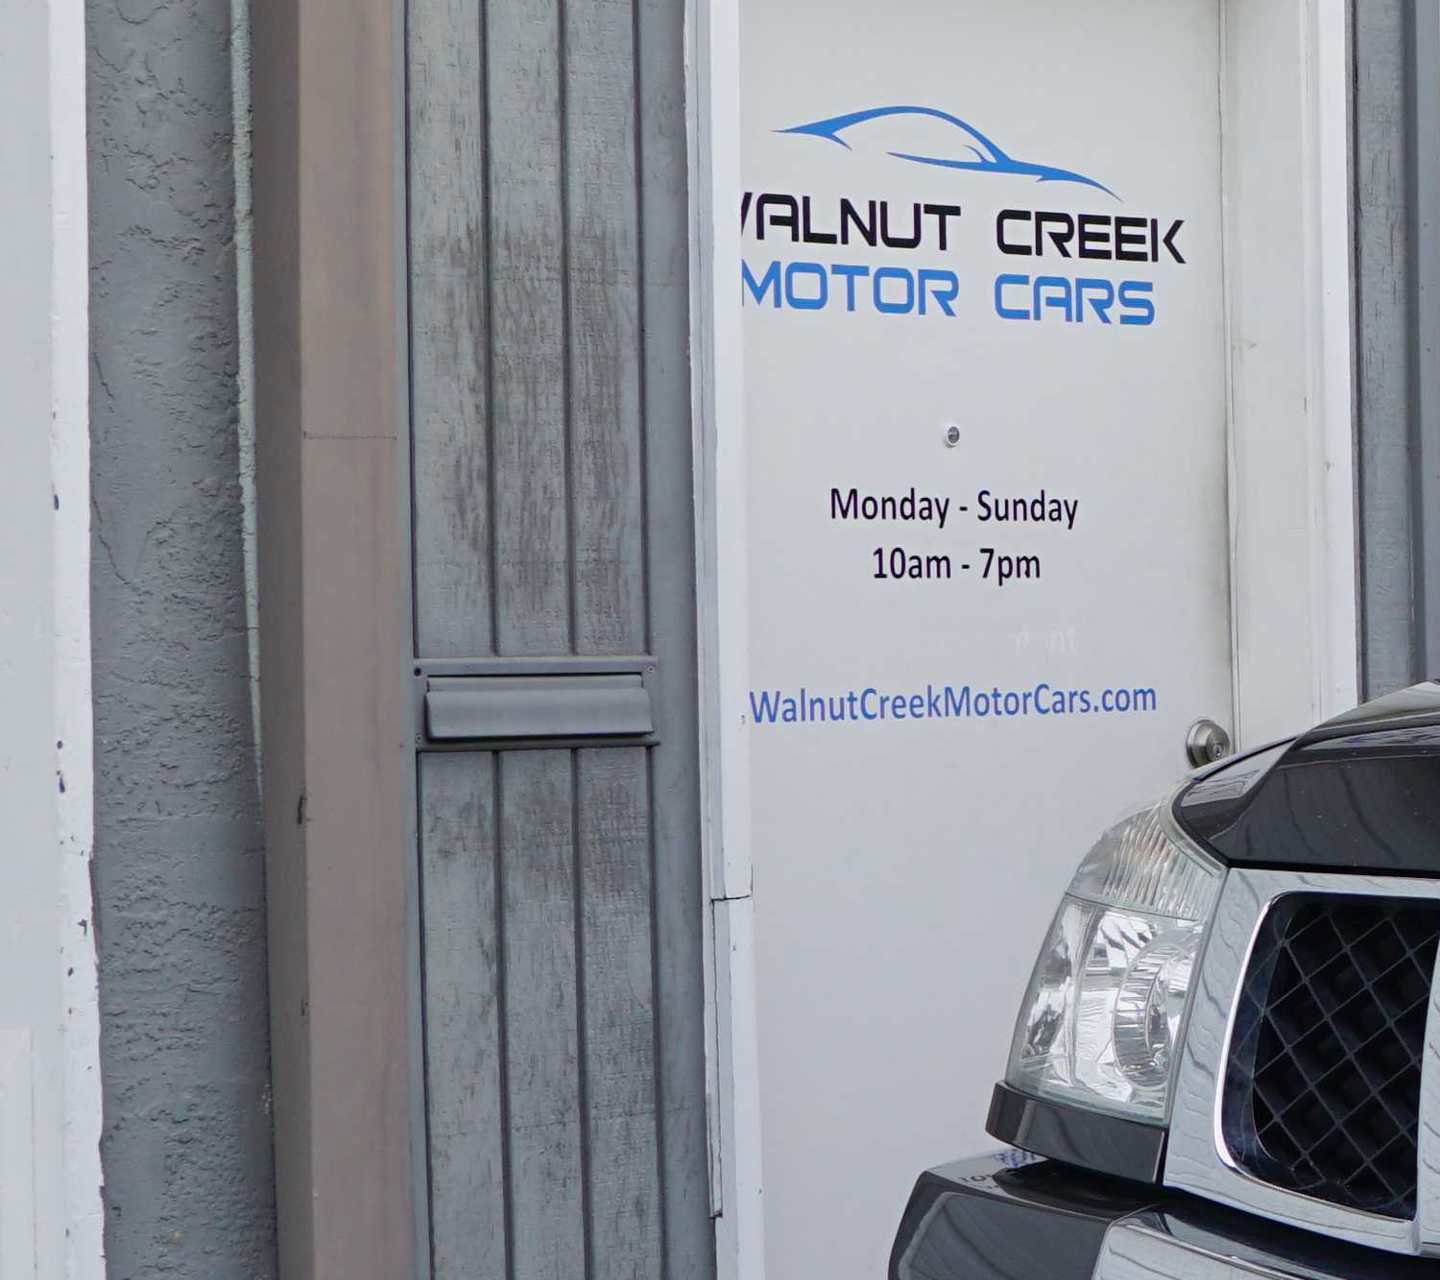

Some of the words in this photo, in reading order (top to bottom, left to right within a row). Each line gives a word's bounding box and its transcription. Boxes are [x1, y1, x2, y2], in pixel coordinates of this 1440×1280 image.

[740, 192, 961, 251] ALNUT
[996, 209, 1187, 264] CREEK
[741, 258, 960, 317] MOTOR
[994, 273, 1156, 326] CARS
[829, 487, 950, 529] Monday
[976, 489, 1079, 530] Sunday
[872, 547, 952, 580] 10am
[979, 548, 1042, 587] 7pm
[749, 682, 1157, 724] WalnutCreekMotorCars.com
